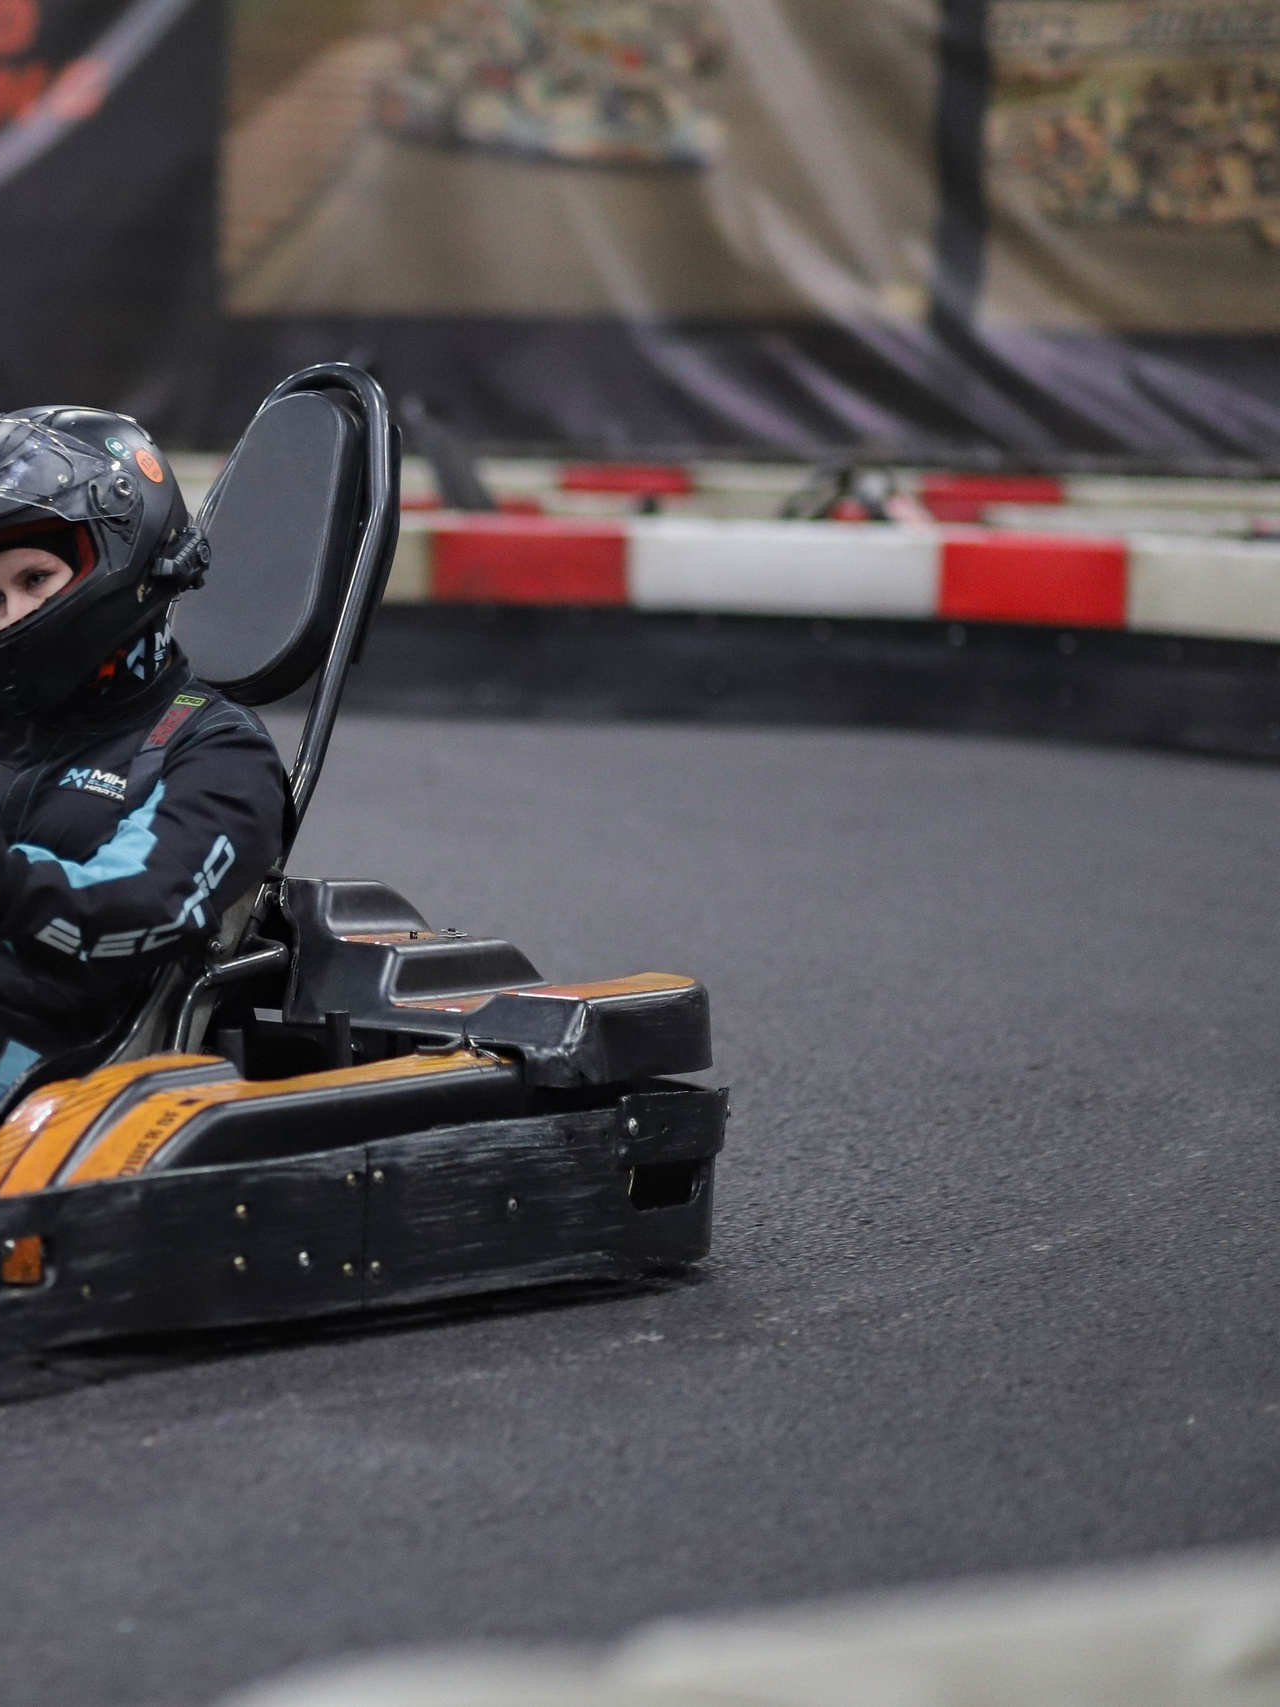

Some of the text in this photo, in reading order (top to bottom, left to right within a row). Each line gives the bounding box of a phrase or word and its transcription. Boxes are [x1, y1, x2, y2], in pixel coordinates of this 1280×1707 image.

[110, 441, 124, 452] 10
[91, 769, 128, 788] MIK
[87, 779, 126, 793] ELECT
